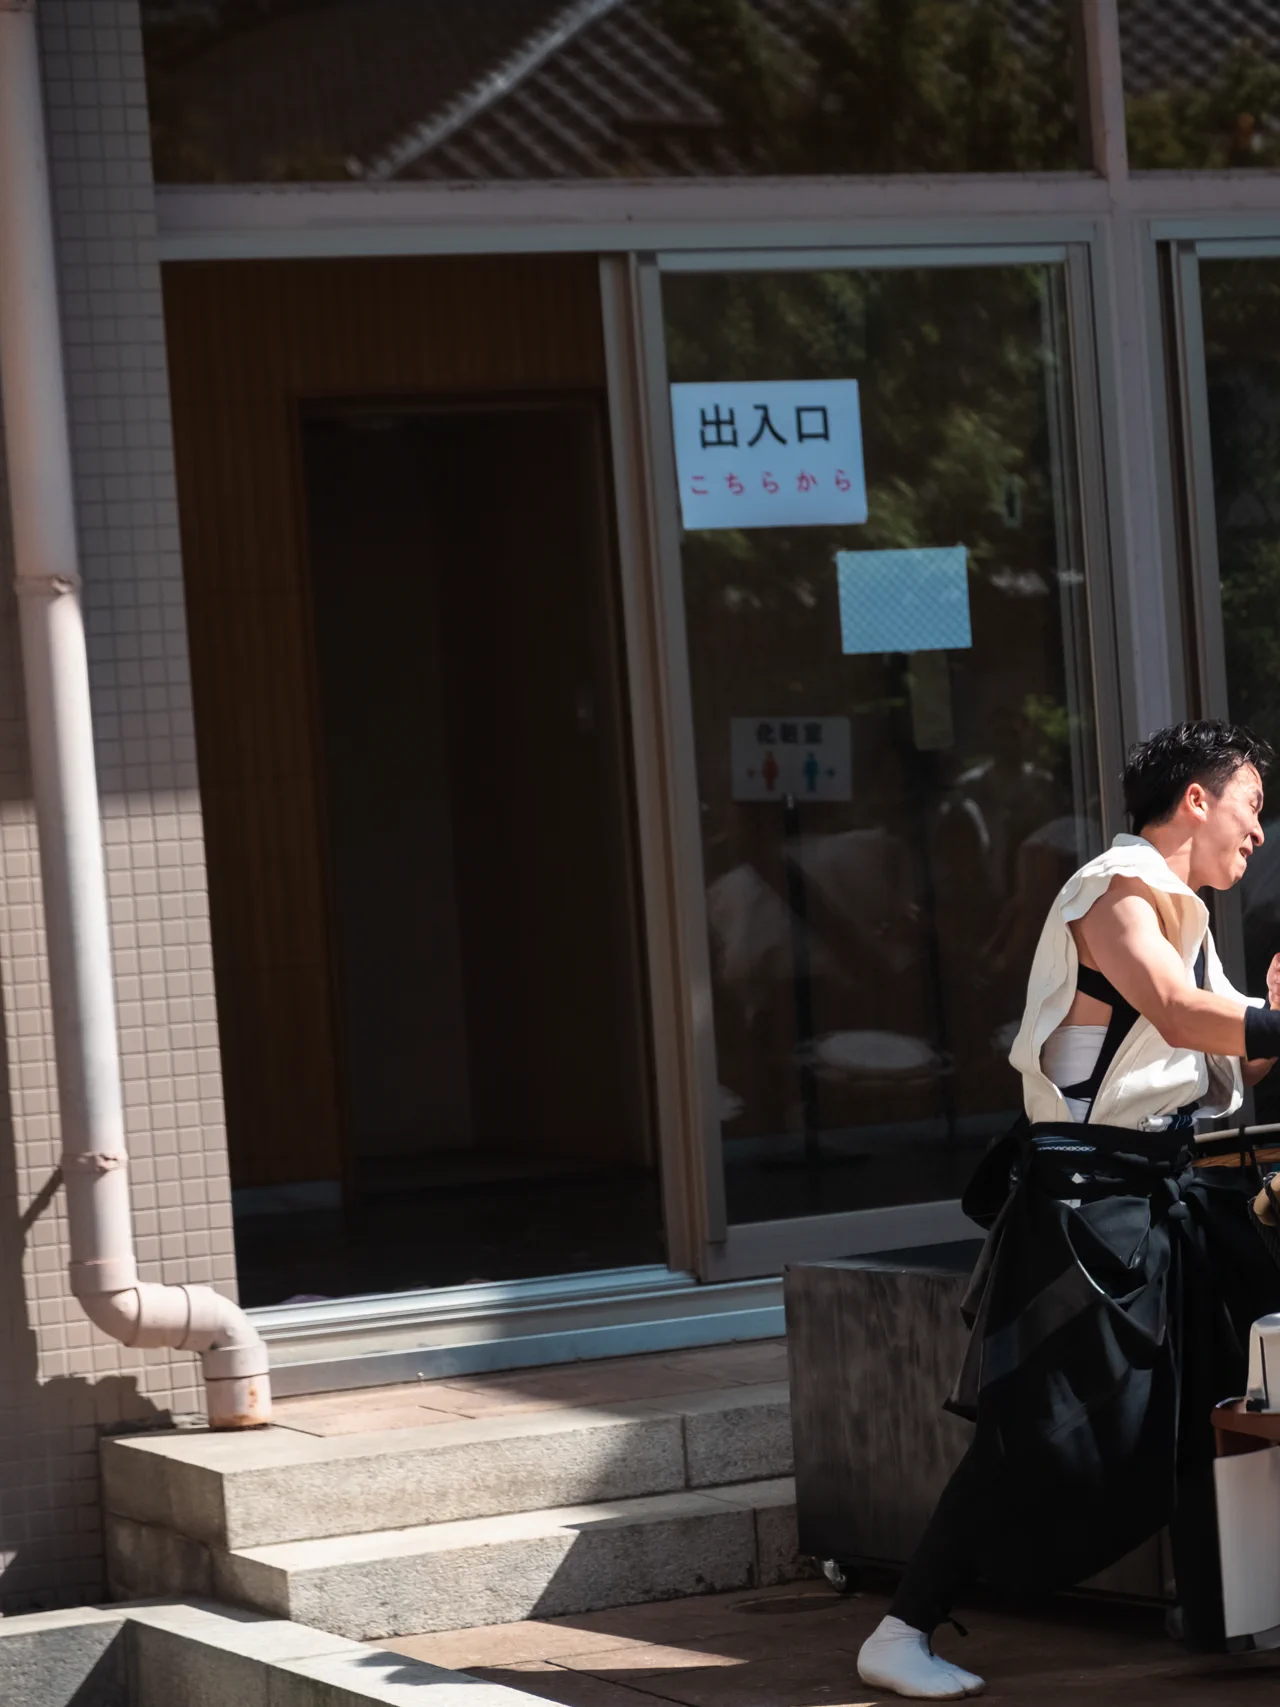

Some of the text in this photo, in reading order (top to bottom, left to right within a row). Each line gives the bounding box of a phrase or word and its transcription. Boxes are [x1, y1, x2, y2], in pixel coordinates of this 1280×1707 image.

[699, 403, 831, 449] 出入口
[691, 468, 853, 496] こちらから
